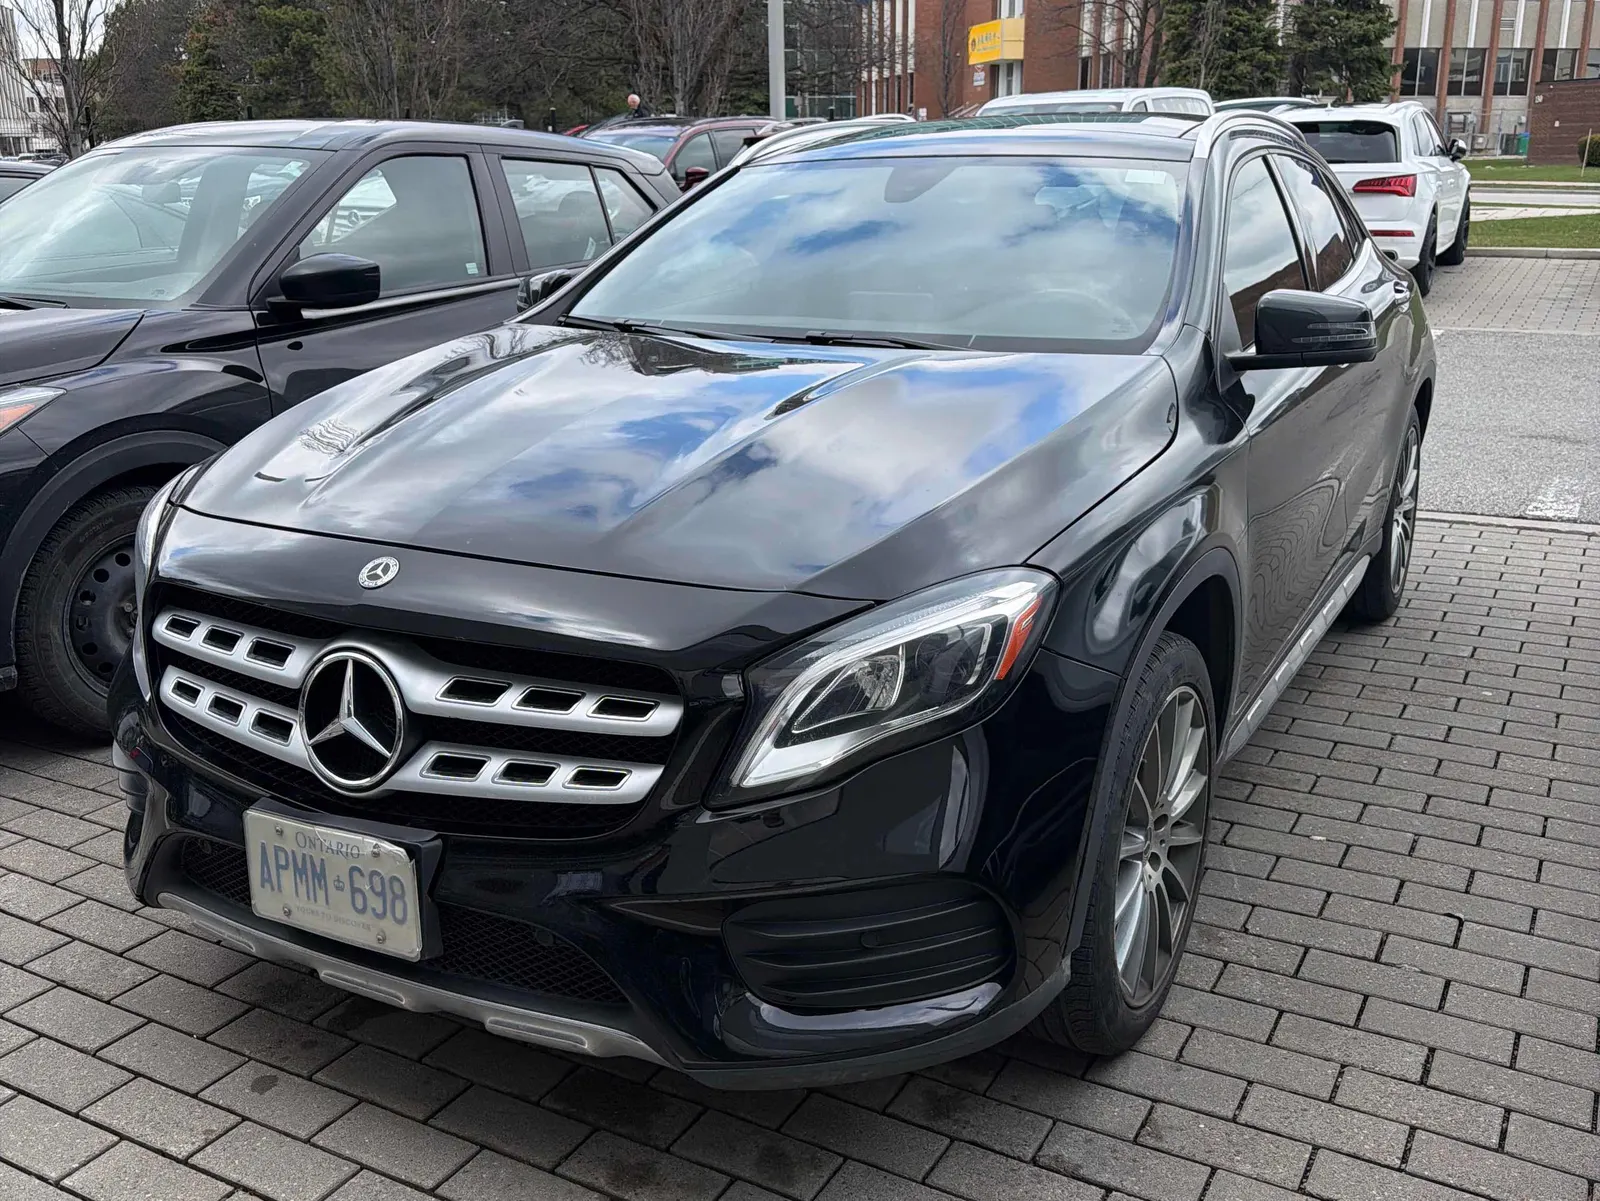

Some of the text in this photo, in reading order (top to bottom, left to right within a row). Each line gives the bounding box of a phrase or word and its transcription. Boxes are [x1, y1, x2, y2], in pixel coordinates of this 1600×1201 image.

[295, 831, 360, 859] ONTARIO
[260, 840, 408, 926] APMM 698
